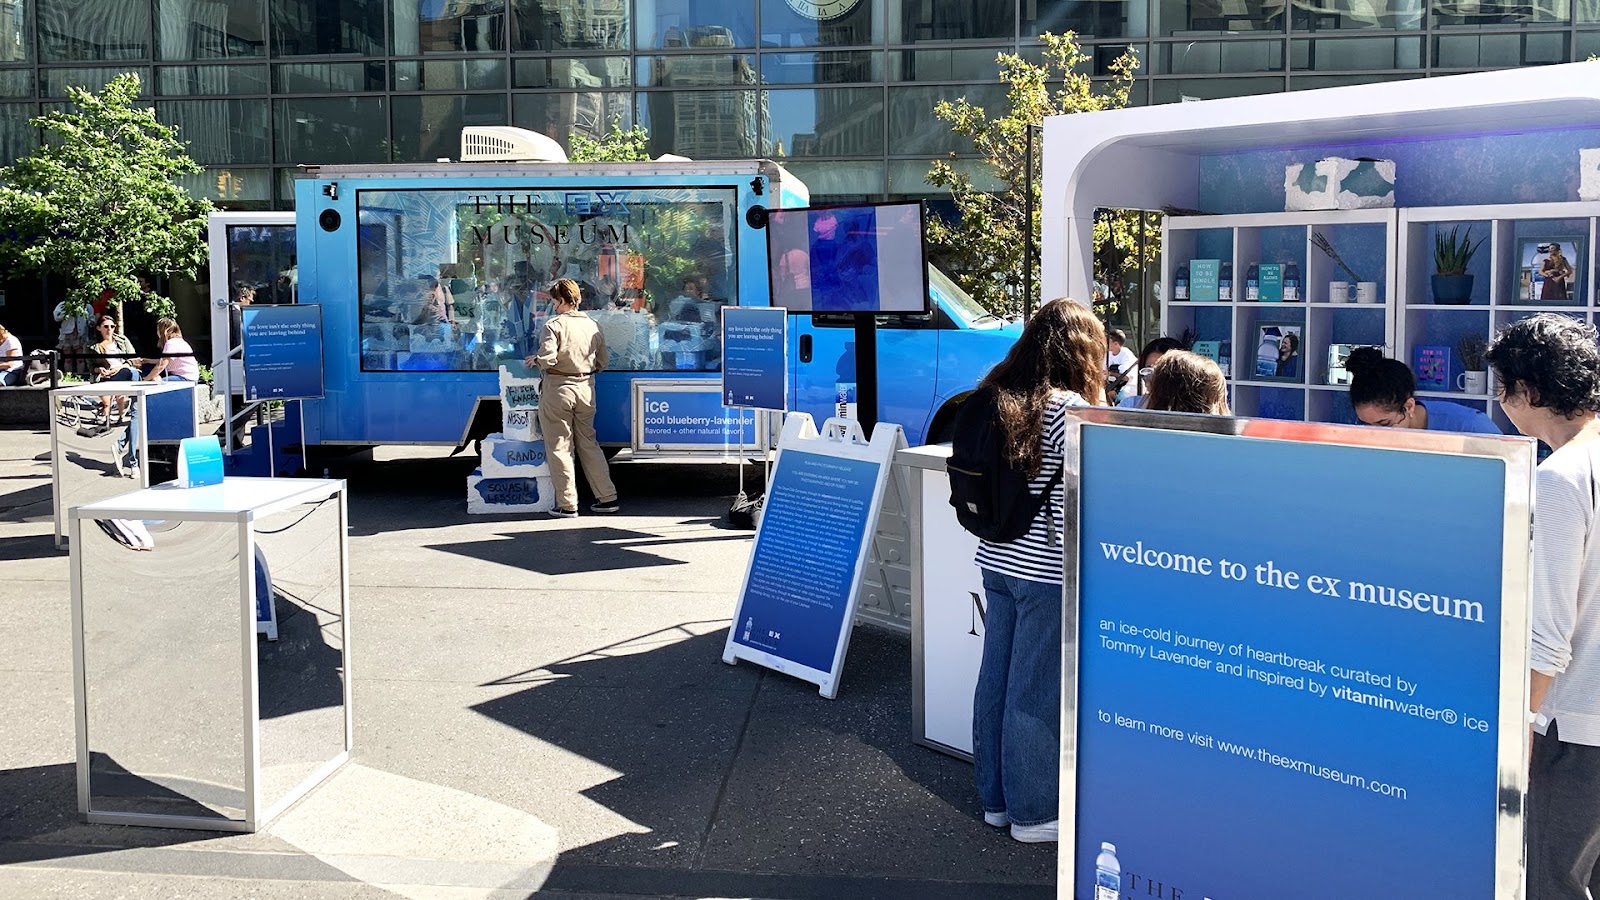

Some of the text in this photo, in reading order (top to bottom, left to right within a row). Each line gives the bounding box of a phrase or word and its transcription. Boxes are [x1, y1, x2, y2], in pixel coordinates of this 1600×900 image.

[468, 192, 631, 215] THE EX
[470, 224, 630, 245] MUSEUM
[302, 322, 316, 330] thing
[770, 327, 782, 335] thing
[744, 333, 758, 341] leaving
[645, 398, 670, 413] ice
[645, 415, 754, 427] cool blueberry-lavender
[488, 482, 530, 492] SQUASH
[487, 492, 533, 502] LESSONS
[1100, 540, 1485, 623] welcome to the ex museum
[768, 630, 781, 639] EX
[1099, 619, 1417, 696] an ice-cold journey of heartbreak curated by
[1099, 634, 1489, 733] Tommy Lavender and inspired by vitaminwater® ice
[1098, 709, 1407, 800] to learn more visit www.theexmuseum.com
[1126, 872, 1184, 900] THE
